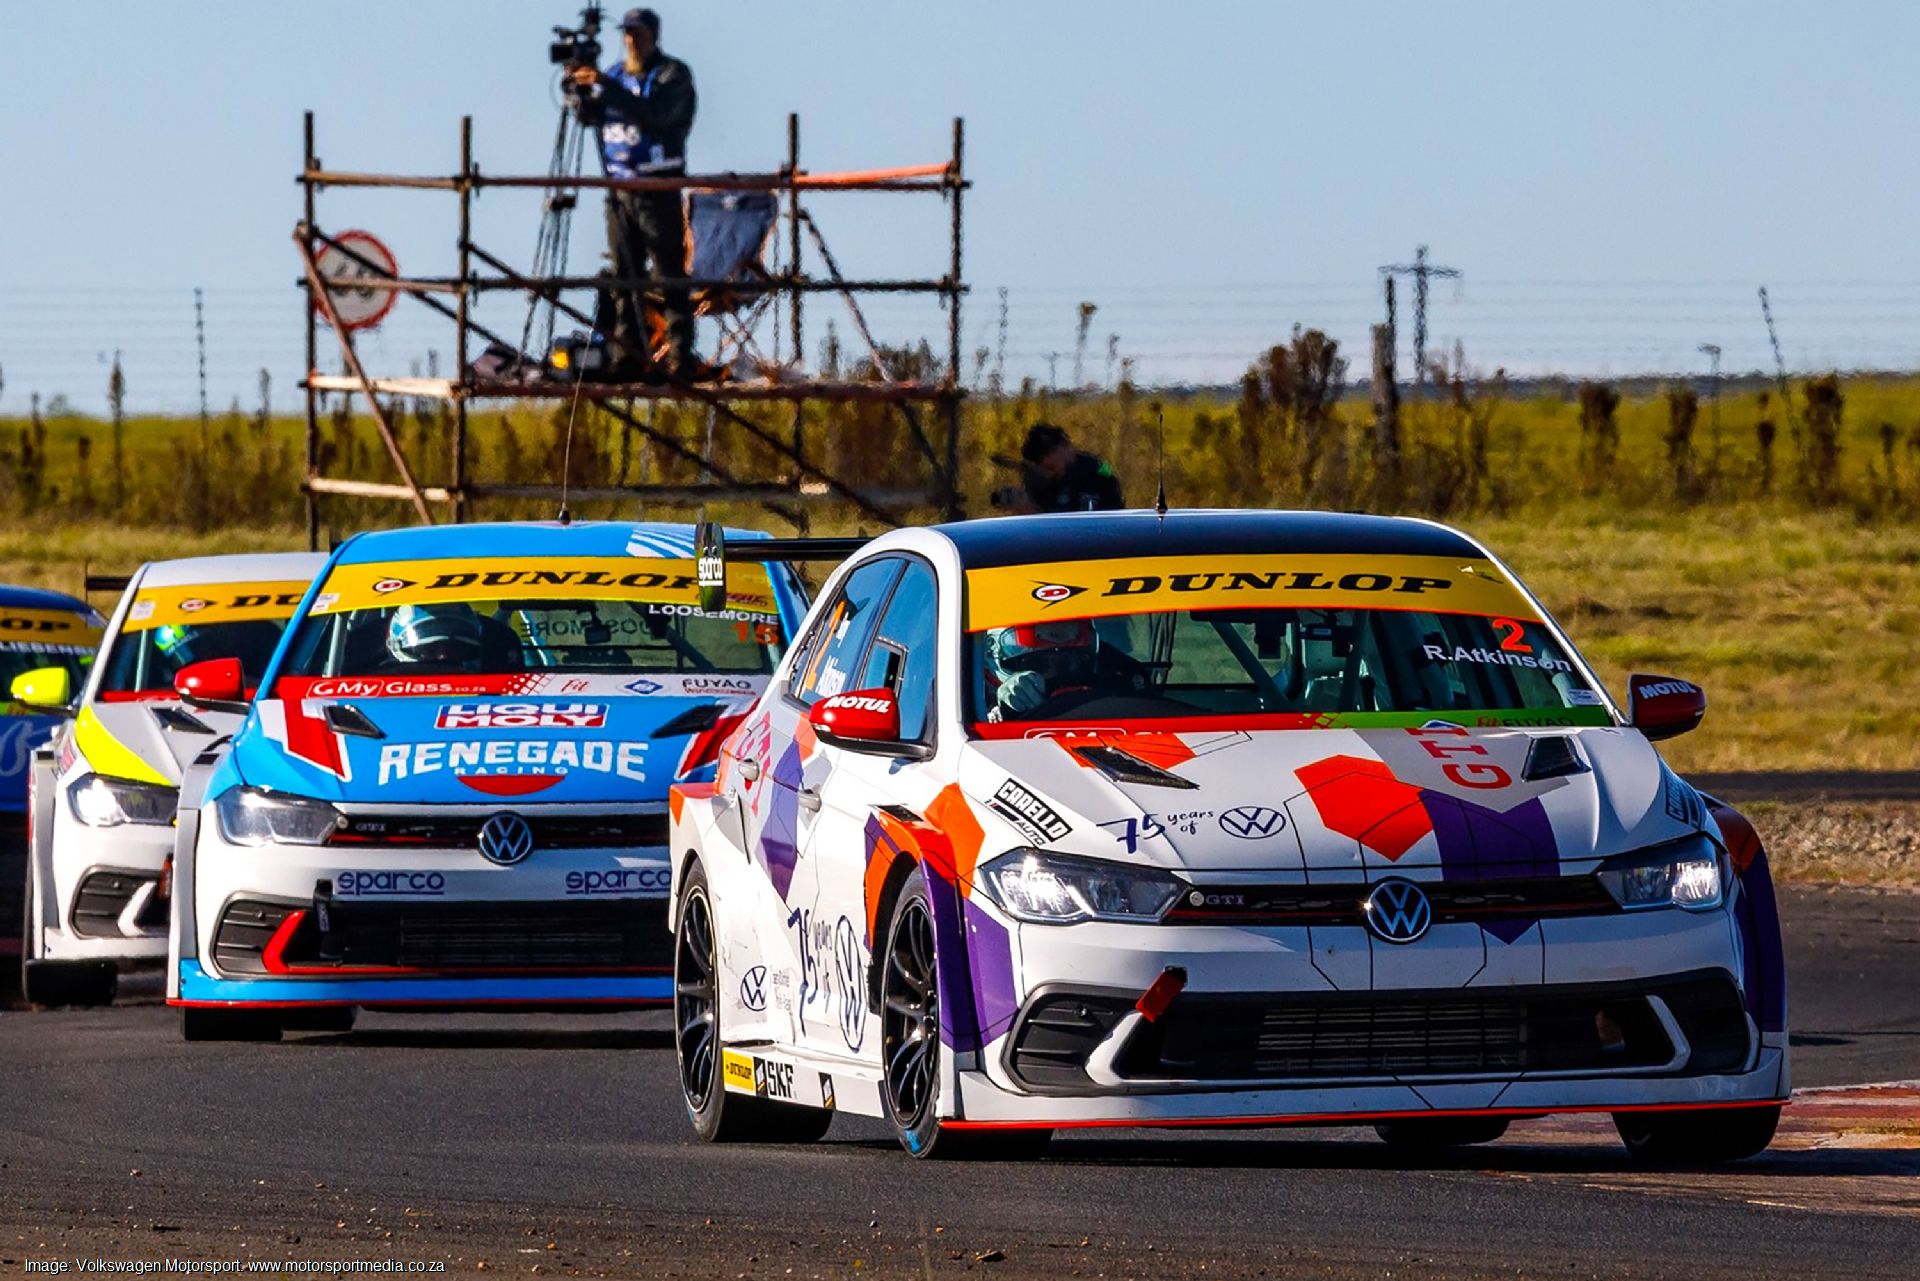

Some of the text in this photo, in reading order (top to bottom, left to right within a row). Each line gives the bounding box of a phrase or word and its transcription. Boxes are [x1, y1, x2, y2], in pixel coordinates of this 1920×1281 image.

[1101, 572, 1453, 597] DUNLOP
[730, 621, 779, 646] 15
[1492, 618, 1533, 653] 2
[1423, 644, 1573, 673] R.Atkinson
[682, 678, 752, 690] FUYAO
[1638, 680, 1697, 699] MOTUL
[447, 703, 601, 714] LIQUI
[823, 695, 892, 713] MOTUL
[445, 714, 602, 727] MOLY
[378, 741, 649, 785] RENEGADE
[454, 766, 569, 775] RACING
[1404, 728, 1512, 789] GTI
[1016, 819, 1047, 846] AUTO
[1096, 809, 1214, 854] 75 years
[1180, 820, 1199, 836] of
[337, 871, 445, 895] sparco
[565, 869, 671, 893] sparco
[1206, 894, 1245, 905] GTI
[767, 1060, 794, 1099] SKF
